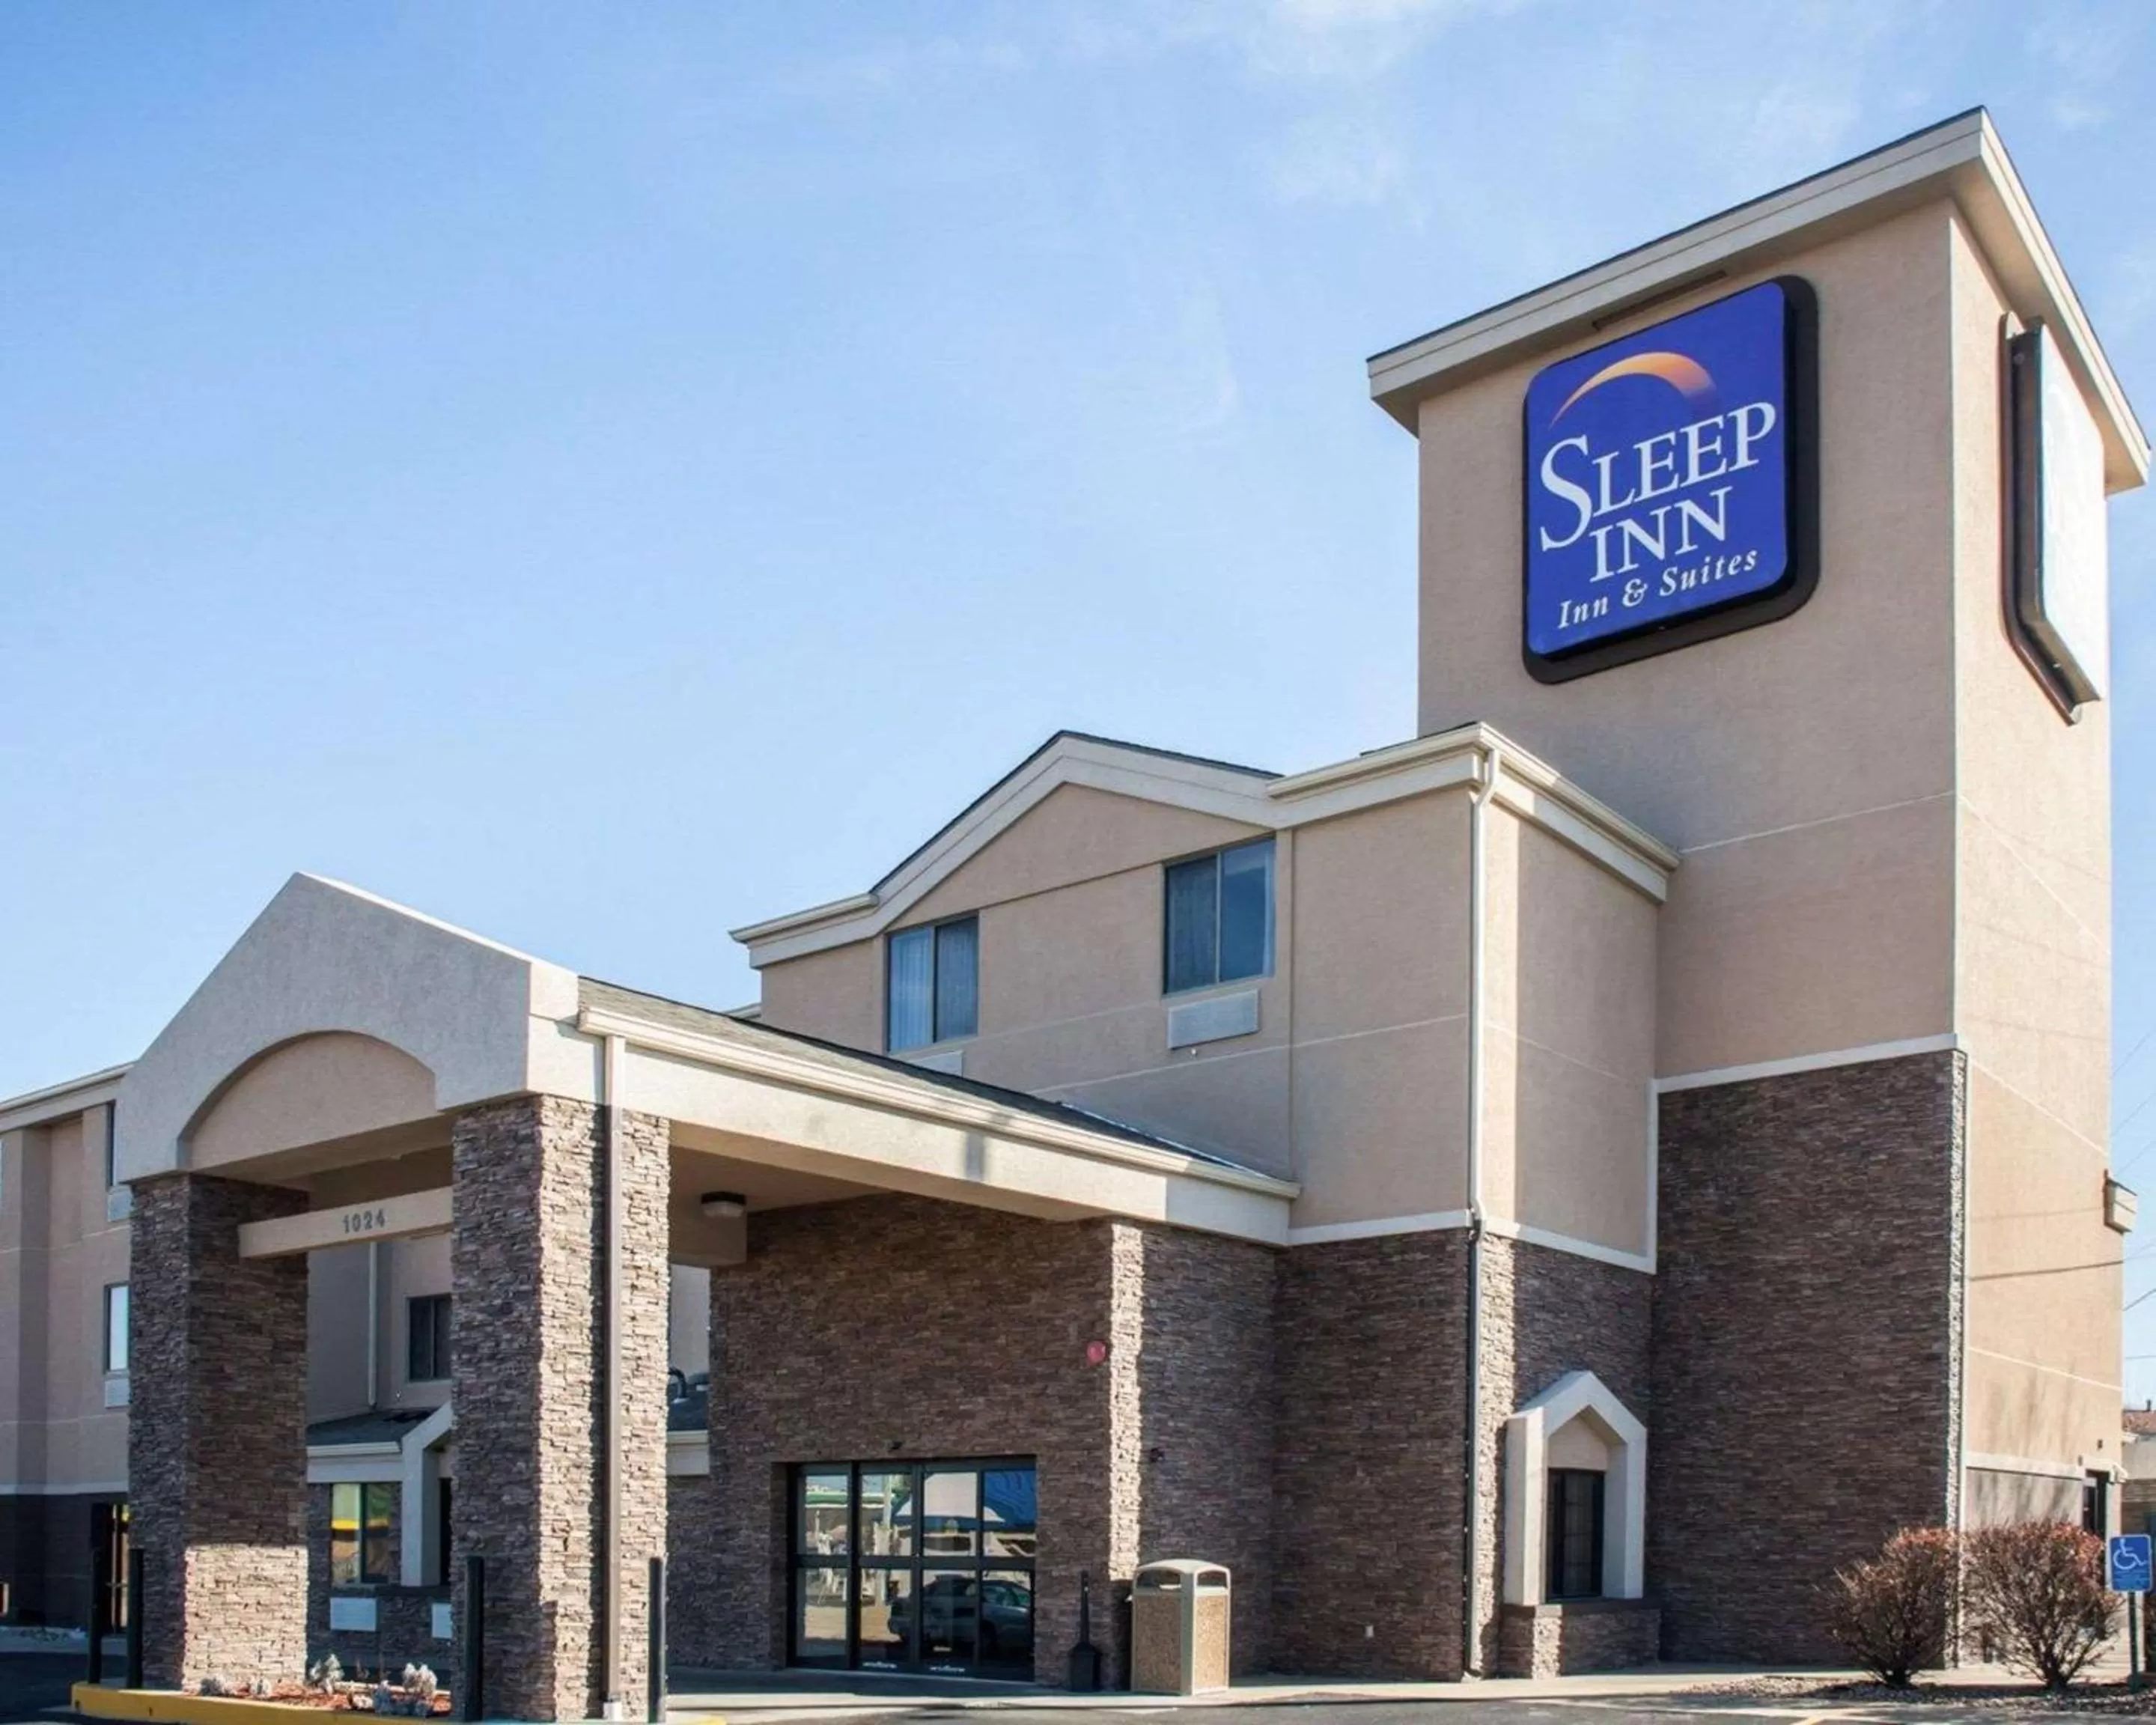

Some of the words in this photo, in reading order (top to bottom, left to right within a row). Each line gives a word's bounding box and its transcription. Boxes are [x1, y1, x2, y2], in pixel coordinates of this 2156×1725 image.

[1540, 401, 1776, 553] SLEEP
[1589, 486, 1732, 582] INN
[1558, 596, 1609, 630] Inn
[1622, 579, 1647, 607] &
[1659, 550, 1758, 597] Suites
